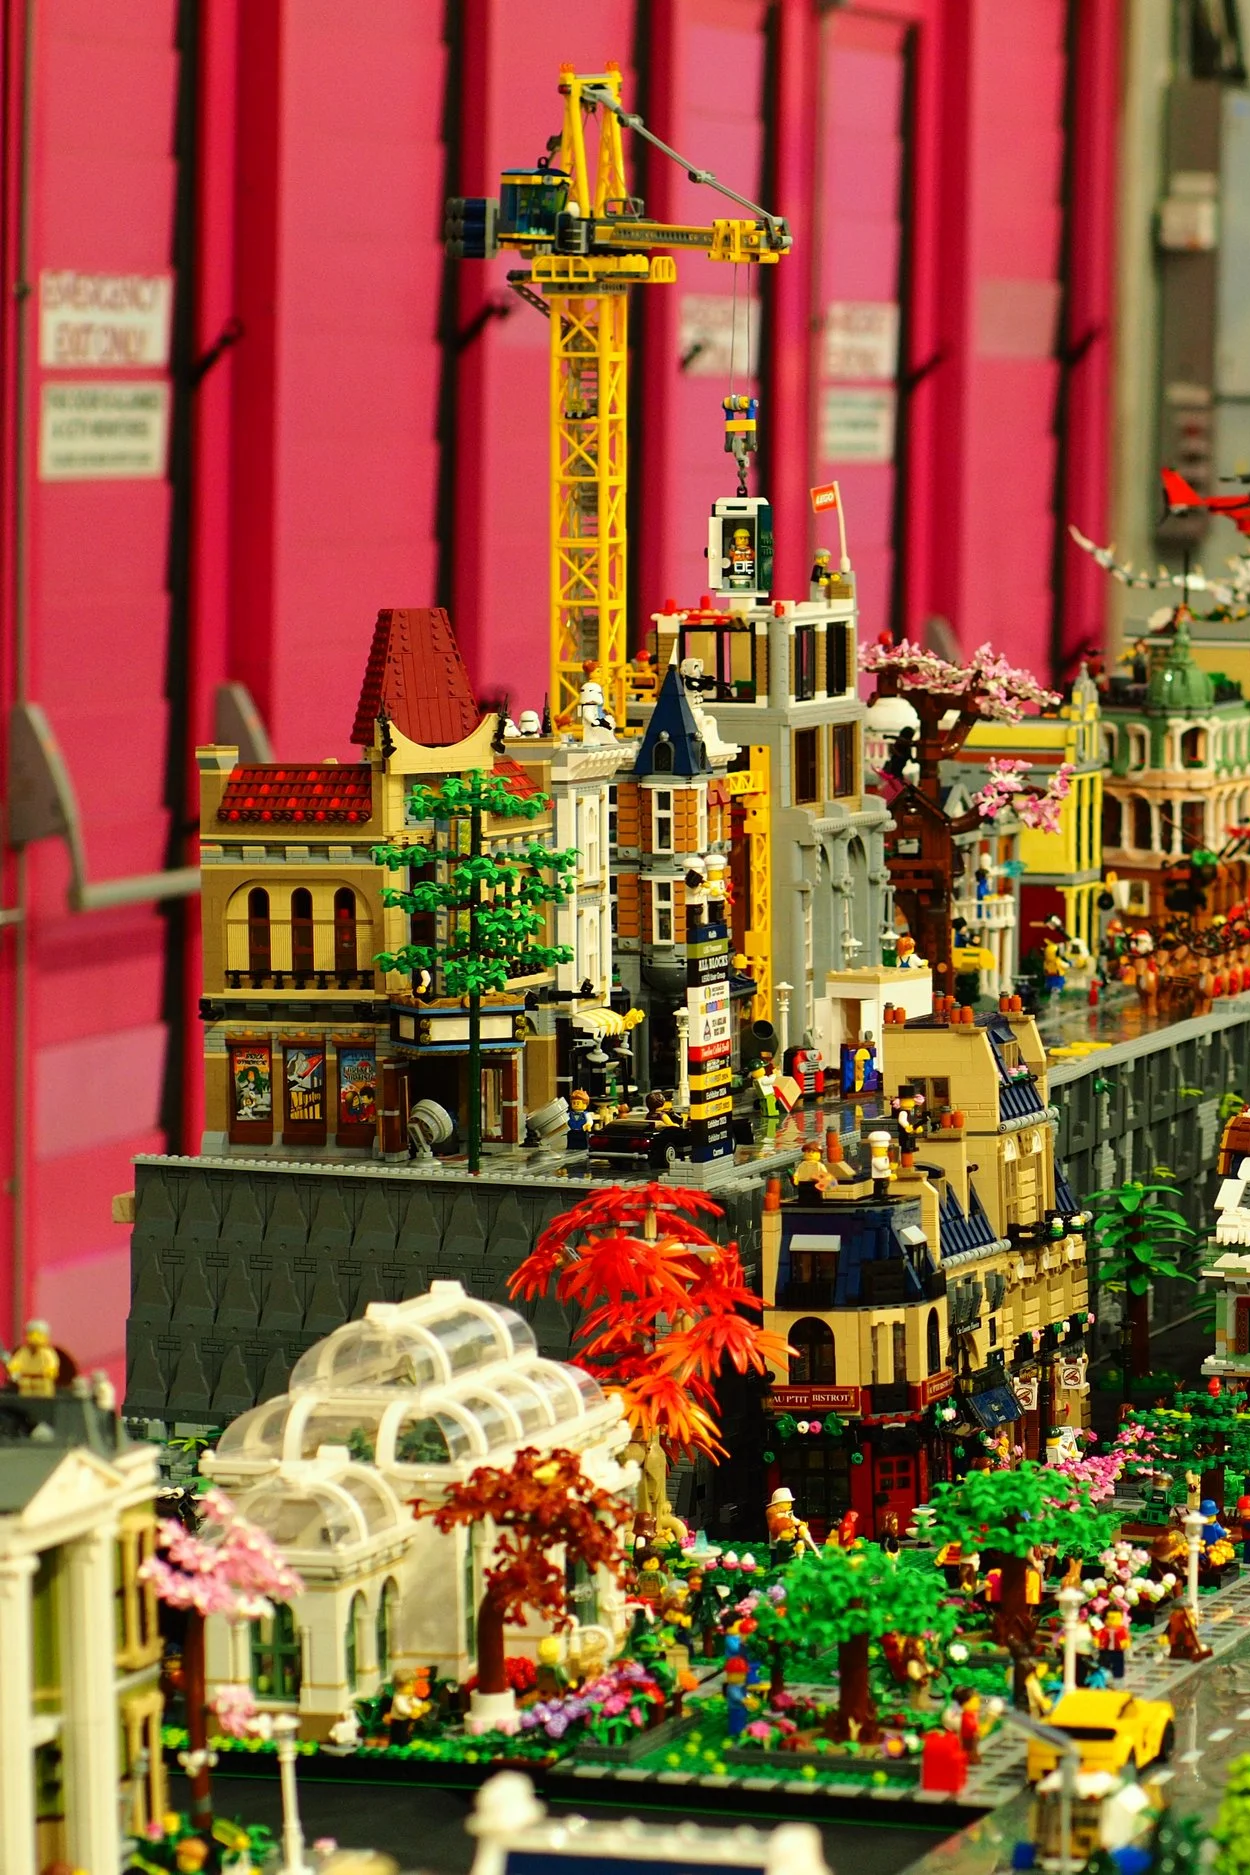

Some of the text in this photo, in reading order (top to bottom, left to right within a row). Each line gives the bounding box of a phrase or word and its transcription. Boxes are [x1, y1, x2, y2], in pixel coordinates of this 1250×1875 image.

[815, 492, 834, 505] LEGO
[698, 955, 728, 972] ALL BLOCKS
[773, 1393, 850, 1404] AU P'TIT BISTROT
